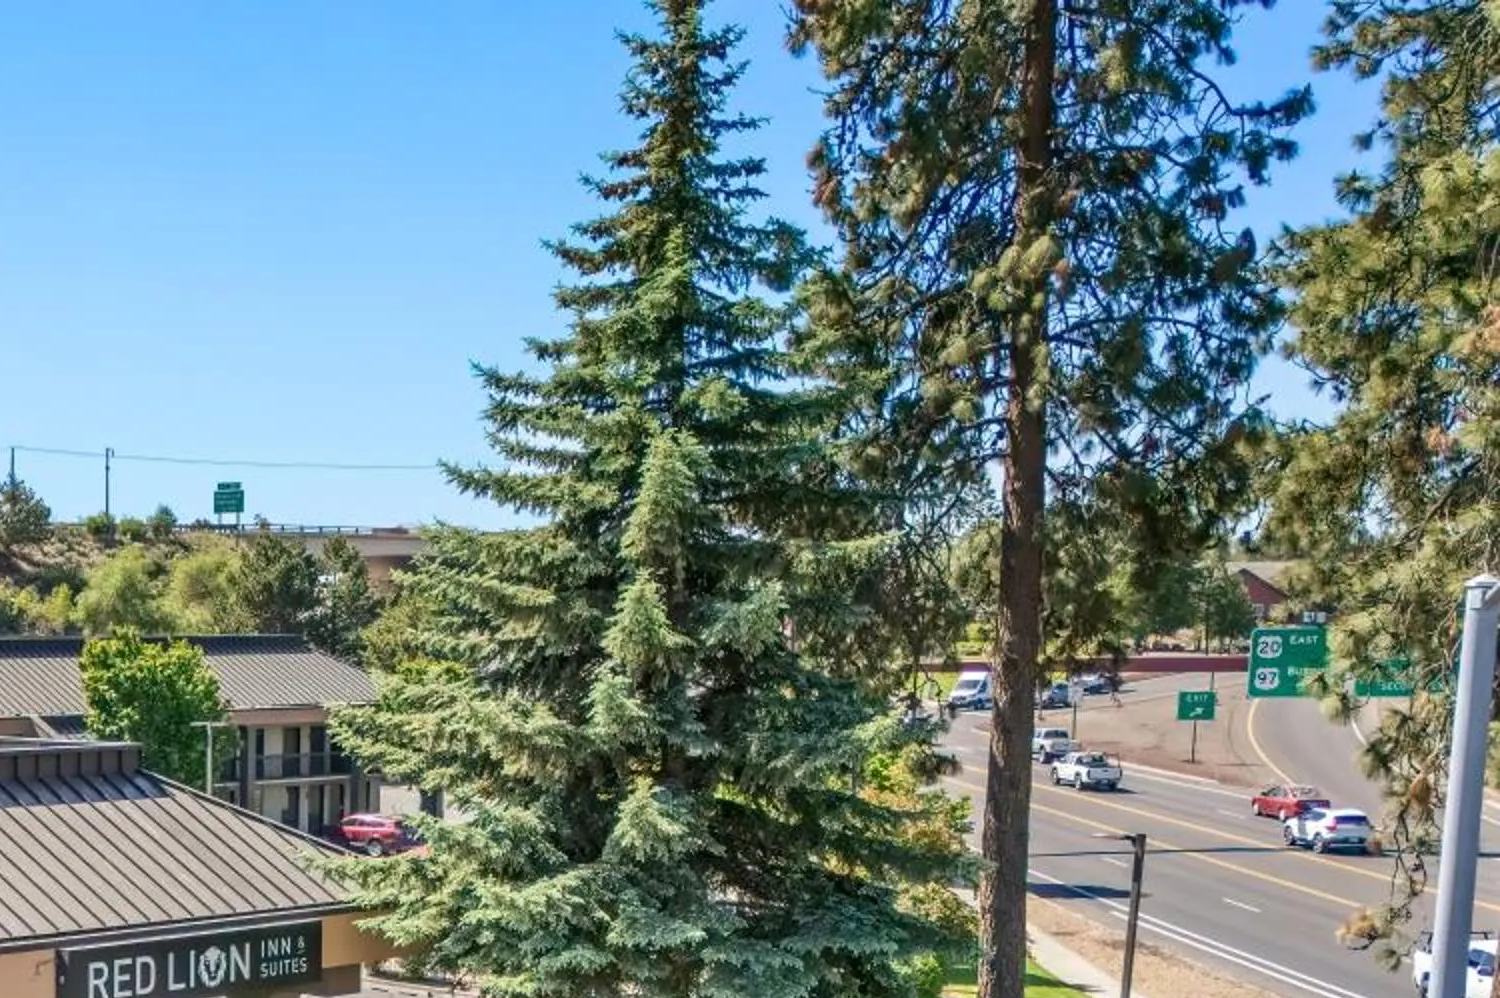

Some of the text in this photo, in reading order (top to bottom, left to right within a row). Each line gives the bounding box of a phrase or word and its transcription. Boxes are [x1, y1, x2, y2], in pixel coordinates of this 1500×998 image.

[1259, 641, 1281, 655] 20
[1288, 635, 1318, 645] EAST
[1257, 672, 1277, 685] 97
[261, 938, 291, 958] INN
[167, 942, 251, 991] LION
[260, 956, 308, 978] SUITES
